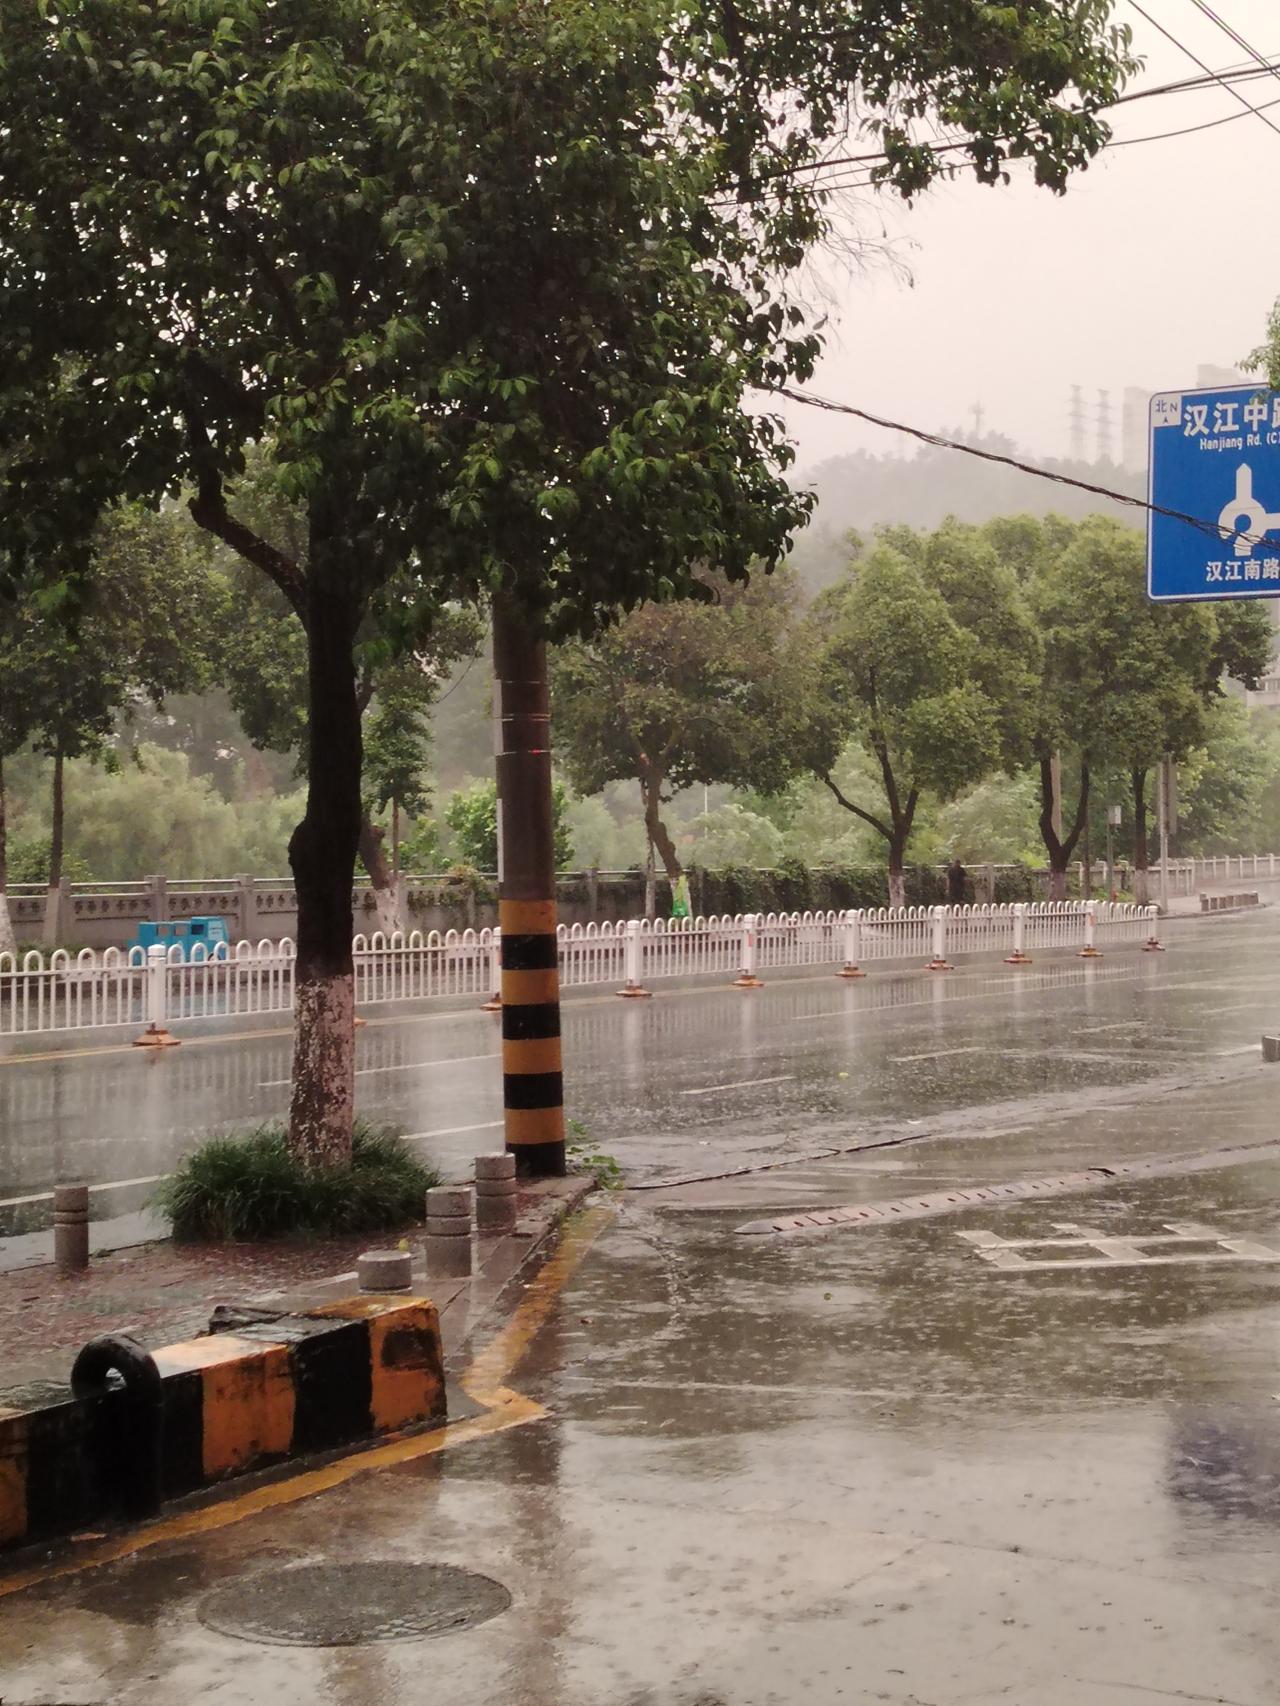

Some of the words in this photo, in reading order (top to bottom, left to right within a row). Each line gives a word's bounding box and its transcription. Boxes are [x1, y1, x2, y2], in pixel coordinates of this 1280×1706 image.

[1155, 399, 1167, 412] 北
[1170, 402, 1178, 412] N
[1200, 436, 1242, 452] Hanjiang
[1247, 433, 1262, 446] Rd.
[1206, 557, 1280, 582] 汉江南路
